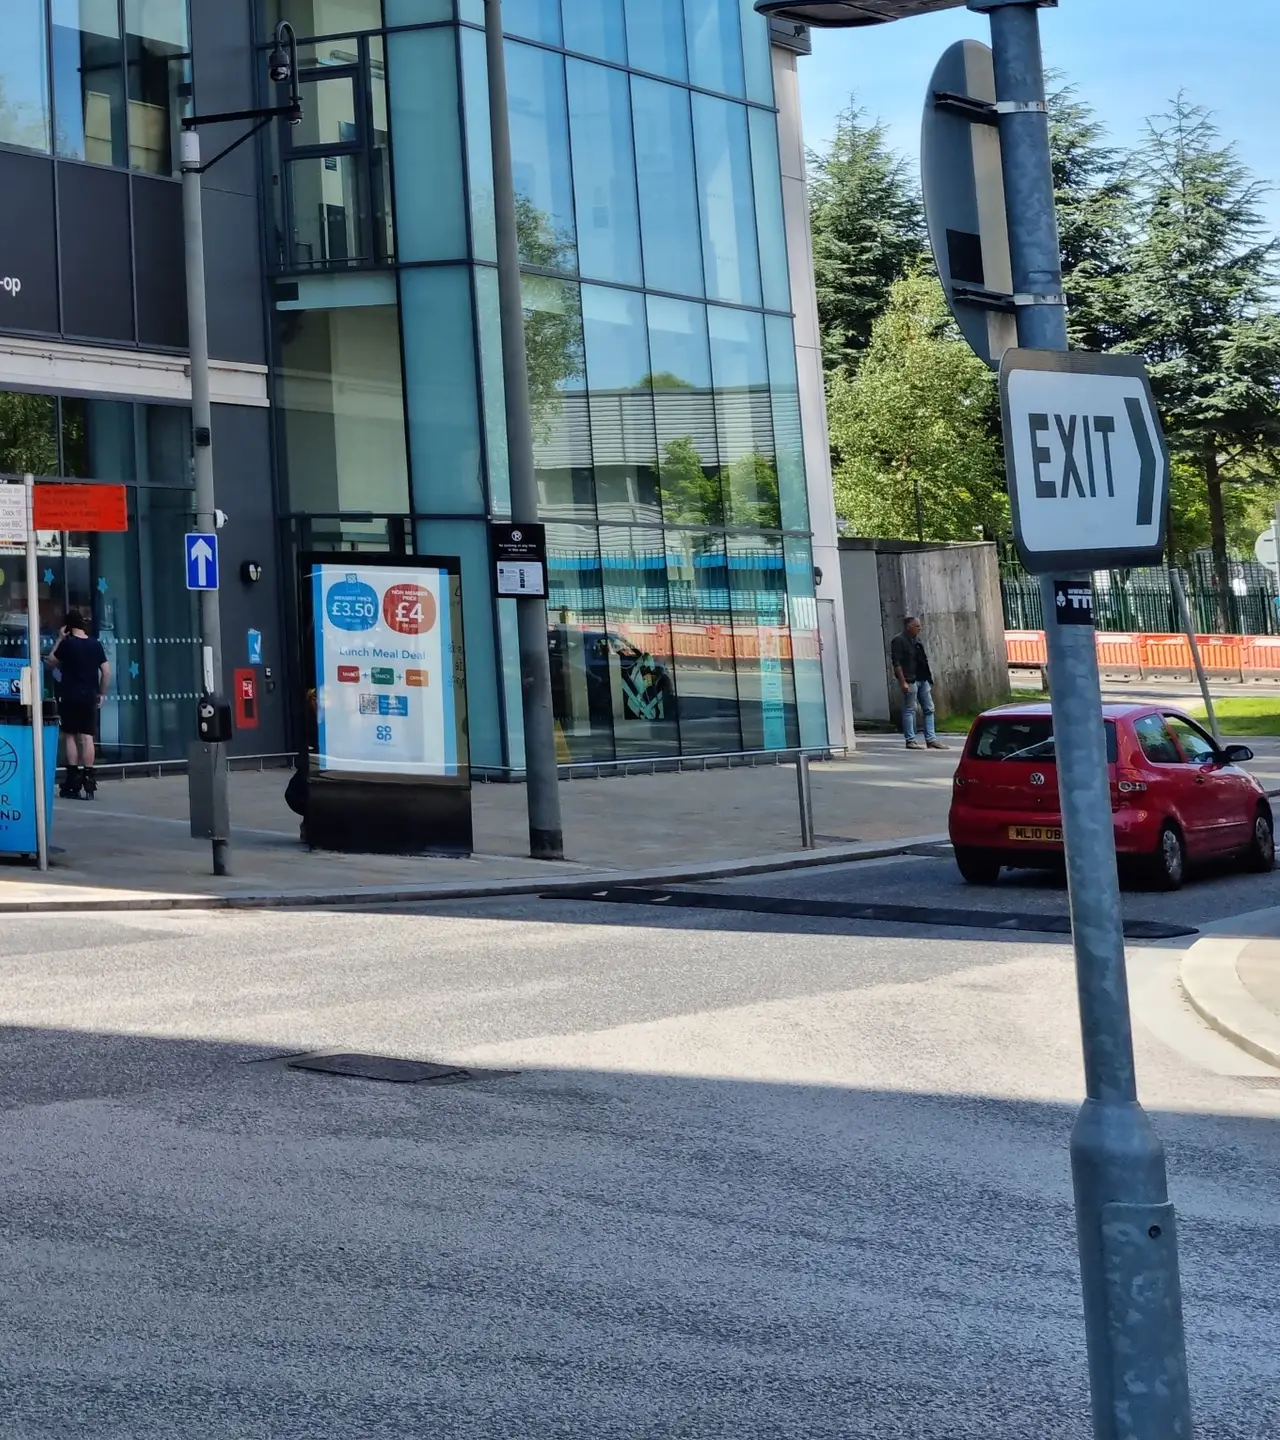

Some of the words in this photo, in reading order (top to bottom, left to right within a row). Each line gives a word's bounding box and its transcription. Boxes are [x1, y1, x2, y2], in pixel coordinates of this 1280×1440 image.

[1028, 413, 1116, 498] EXIT
[2, 508, 15, 516] Dock
[12, 520, 23, 528] BBC
[331, 602, 375, 618] £3.50
[395, 601, 425, 624] £4
[339, 647, 370, 658] Lunch
[372, 648, 399, 659] Meal
[401, 649, 426, 661] Deal
[1015, 828, 1041, 840] ML10
[1045, 828, 1064, 840] OB
